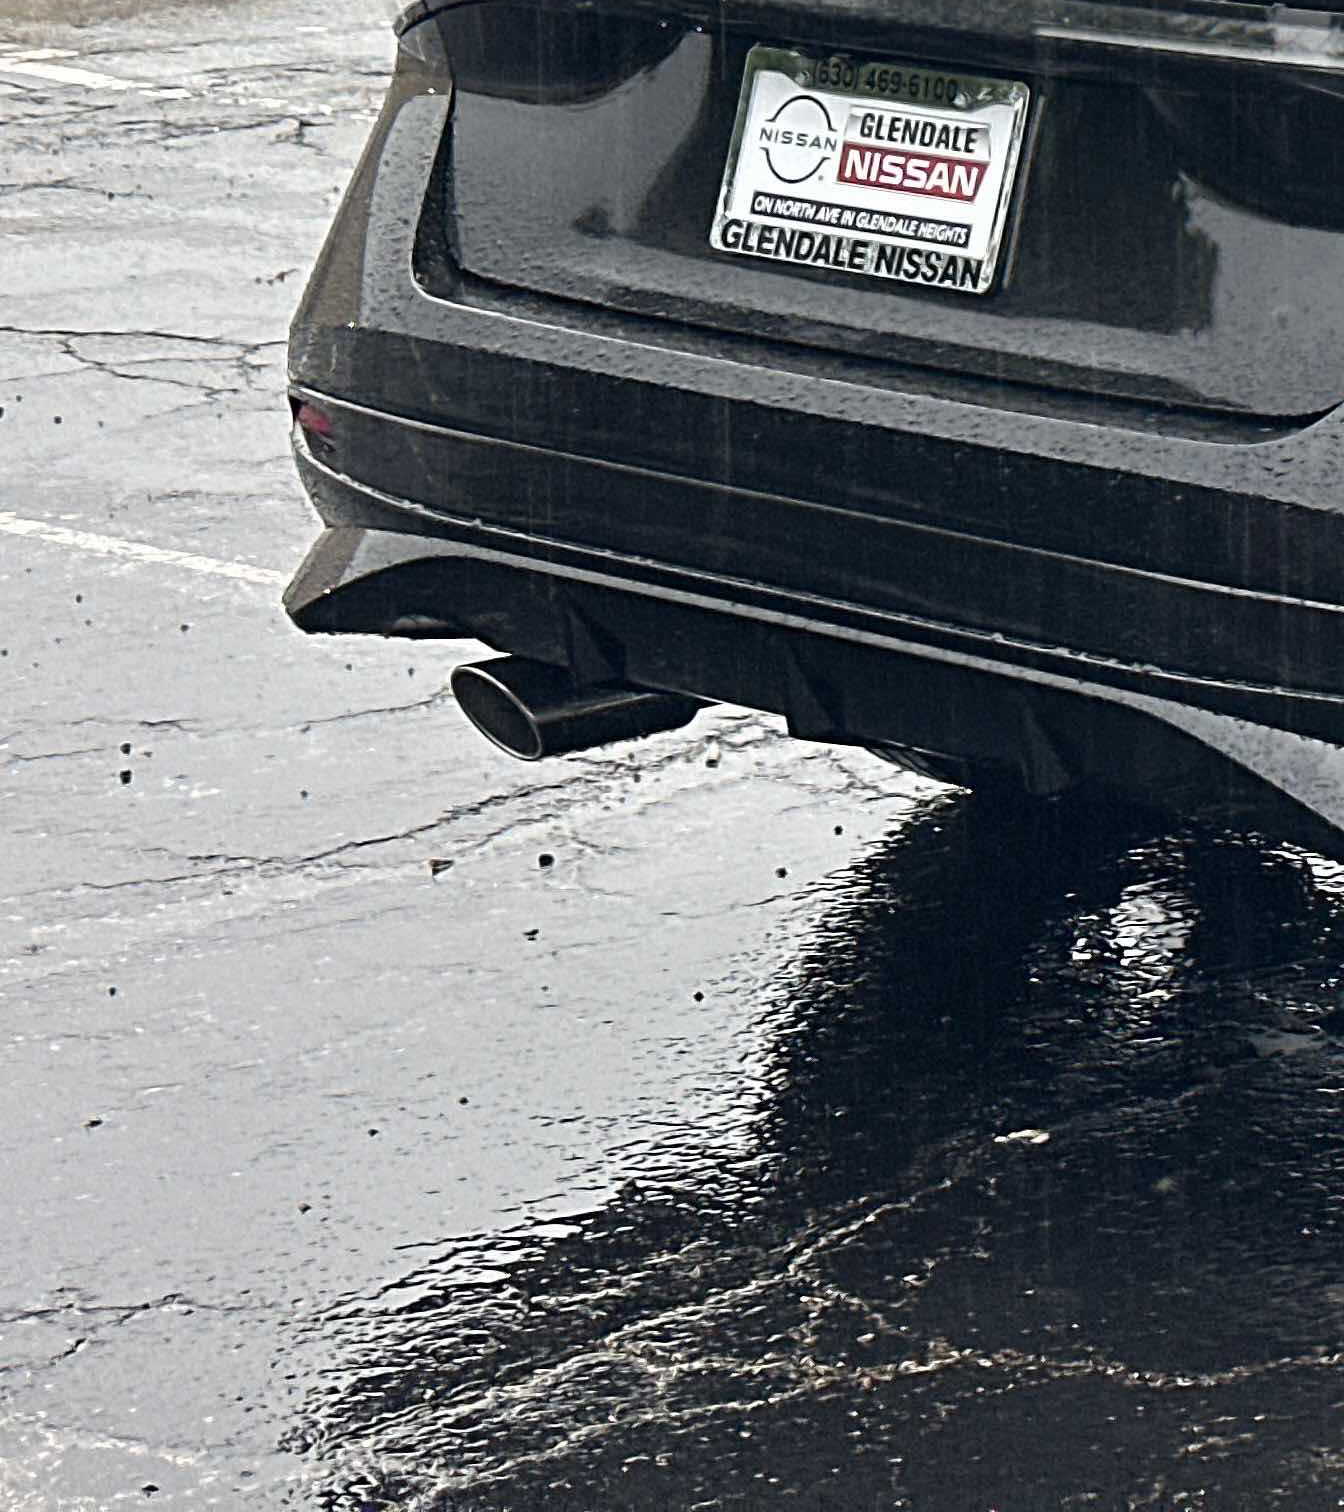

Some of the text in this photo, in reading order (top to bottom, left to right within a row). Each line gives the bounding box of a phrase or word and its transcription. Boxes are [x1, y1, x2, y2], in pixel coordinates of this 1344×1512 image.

[759, 126, 838, 153] NISSAN
[860, 112, 979, 154] GLENDALE
[844, 149, 979, 197] NISSAN
[753, 195, 773, 215] ON
[774, 198, 817, 221] NORTH
[815, 206, 842, 226] AVE
[841, 210, 857, 227] IN
[855, 212, 919, 236] GLENDALE
[720, 218, 983, 290] GLENDALE NISSAN
